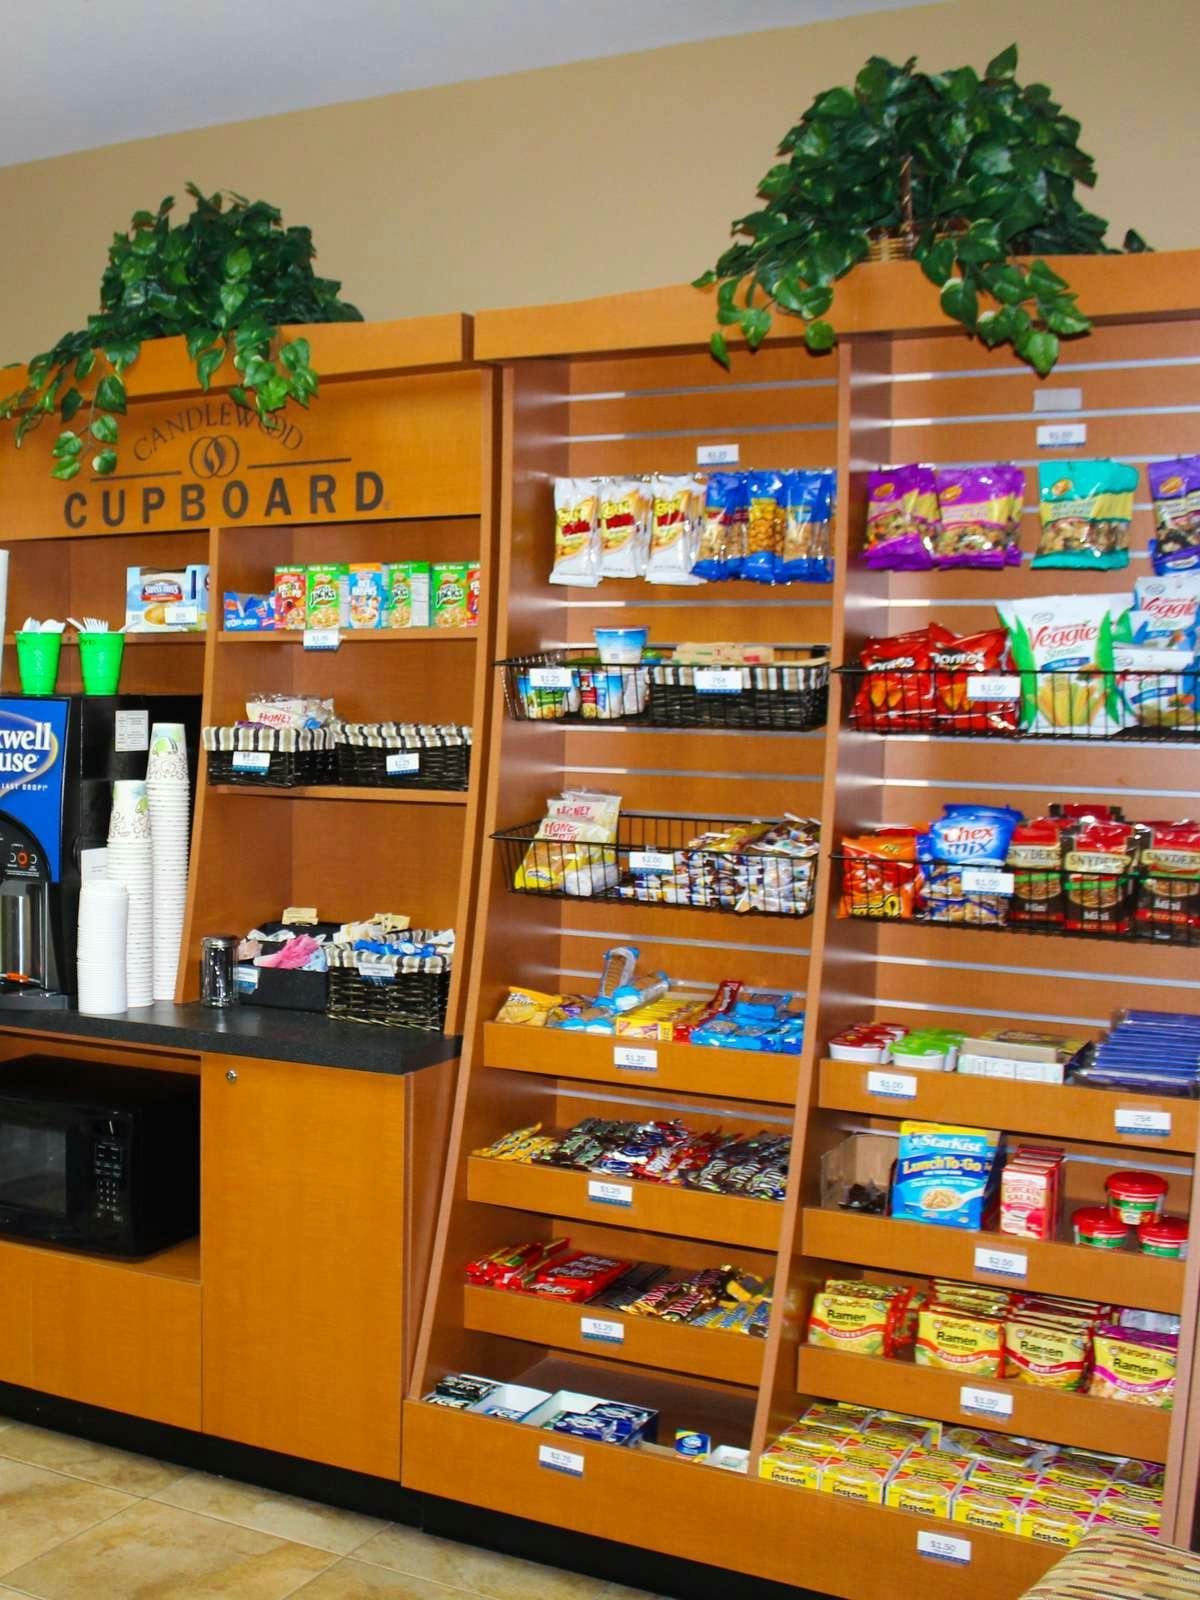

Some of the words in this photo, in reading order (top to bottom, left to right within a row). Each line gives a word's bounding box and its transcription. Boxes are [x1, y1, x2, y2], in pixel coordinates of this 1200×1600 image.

[64, 471, 384, 529] CUPBOARD
[1028, 624, 1098, 651] Veggie
[943, 826, 994, 844] Chex
[947, 838, 994, 857] mix
[827, 1309, 866, 1322] Ramen
[937, 1331, 978, 1347] Ramen
[1020, 1340, 1064, 1358] Ramen
[1113, 1358, 1159, 1376] Ramen
